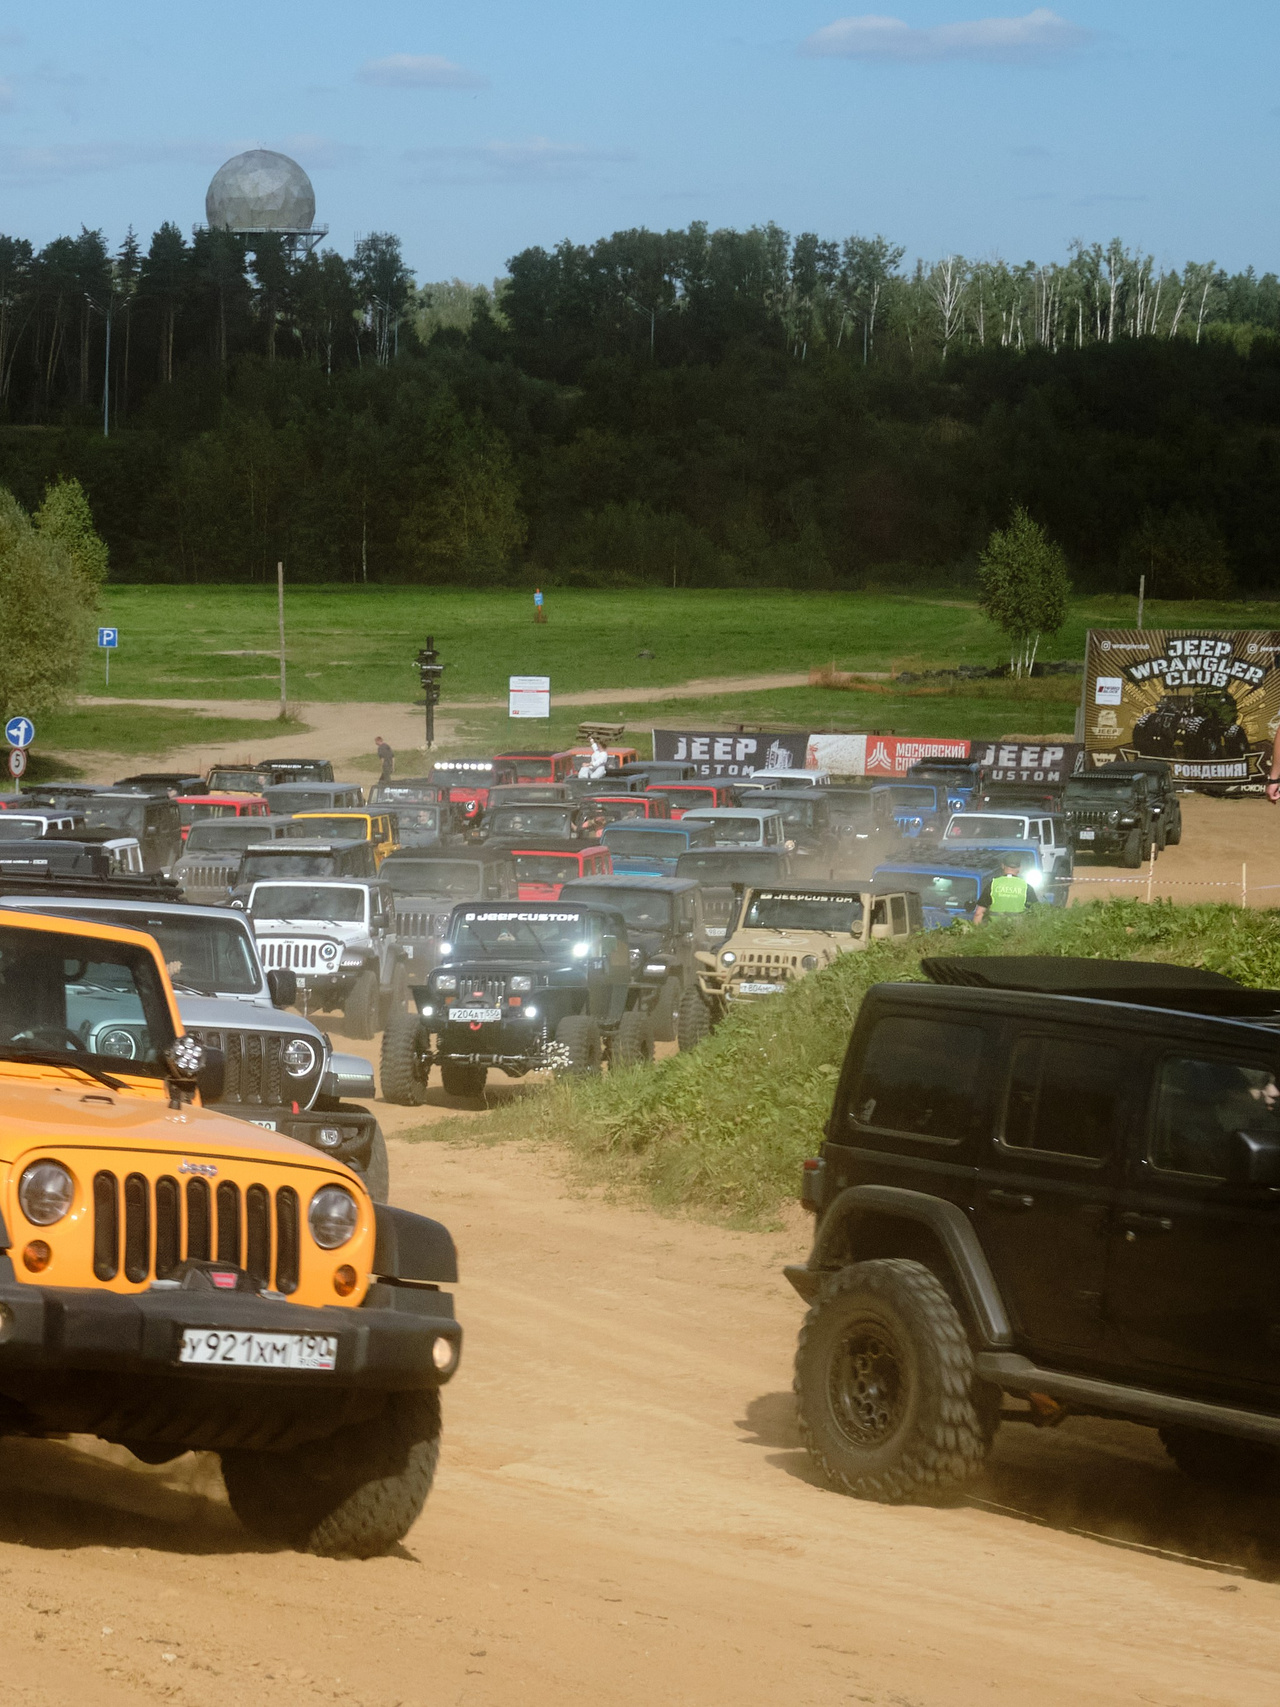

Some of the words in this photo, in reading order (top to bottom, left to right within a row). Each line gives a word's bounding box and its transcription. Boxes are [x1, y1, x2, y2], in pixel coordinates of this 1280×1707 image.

[103, 630, 114, 645] P
[1167, 639, 1232, 657] JEEP
[1129, 656, 1264, 684] WRANGLER
[1165, 670, 1229, 688] CLUB
[673, 737, 757, 761] JEEP
[895, 742, 965, 758] МОСКОВСКИЙ
[980, 744, 1064, 768] JEEP
[14, 753, 21, 768] 5
[694, 764, 755, 776] STOM
[992, 769, 1060, 782] USTOM
[1173, 762, 1248, 779] РОЖДЕНИЯ!
[1240, 784, 1266, 793] YOKOH
[995, 885, 1022, 895] CAESAR
[177, 1159, 218, 1178] Jeep
[187, 1332, 288, 1365] У921ХМ
[293, 1335, 330, 1358] 190
